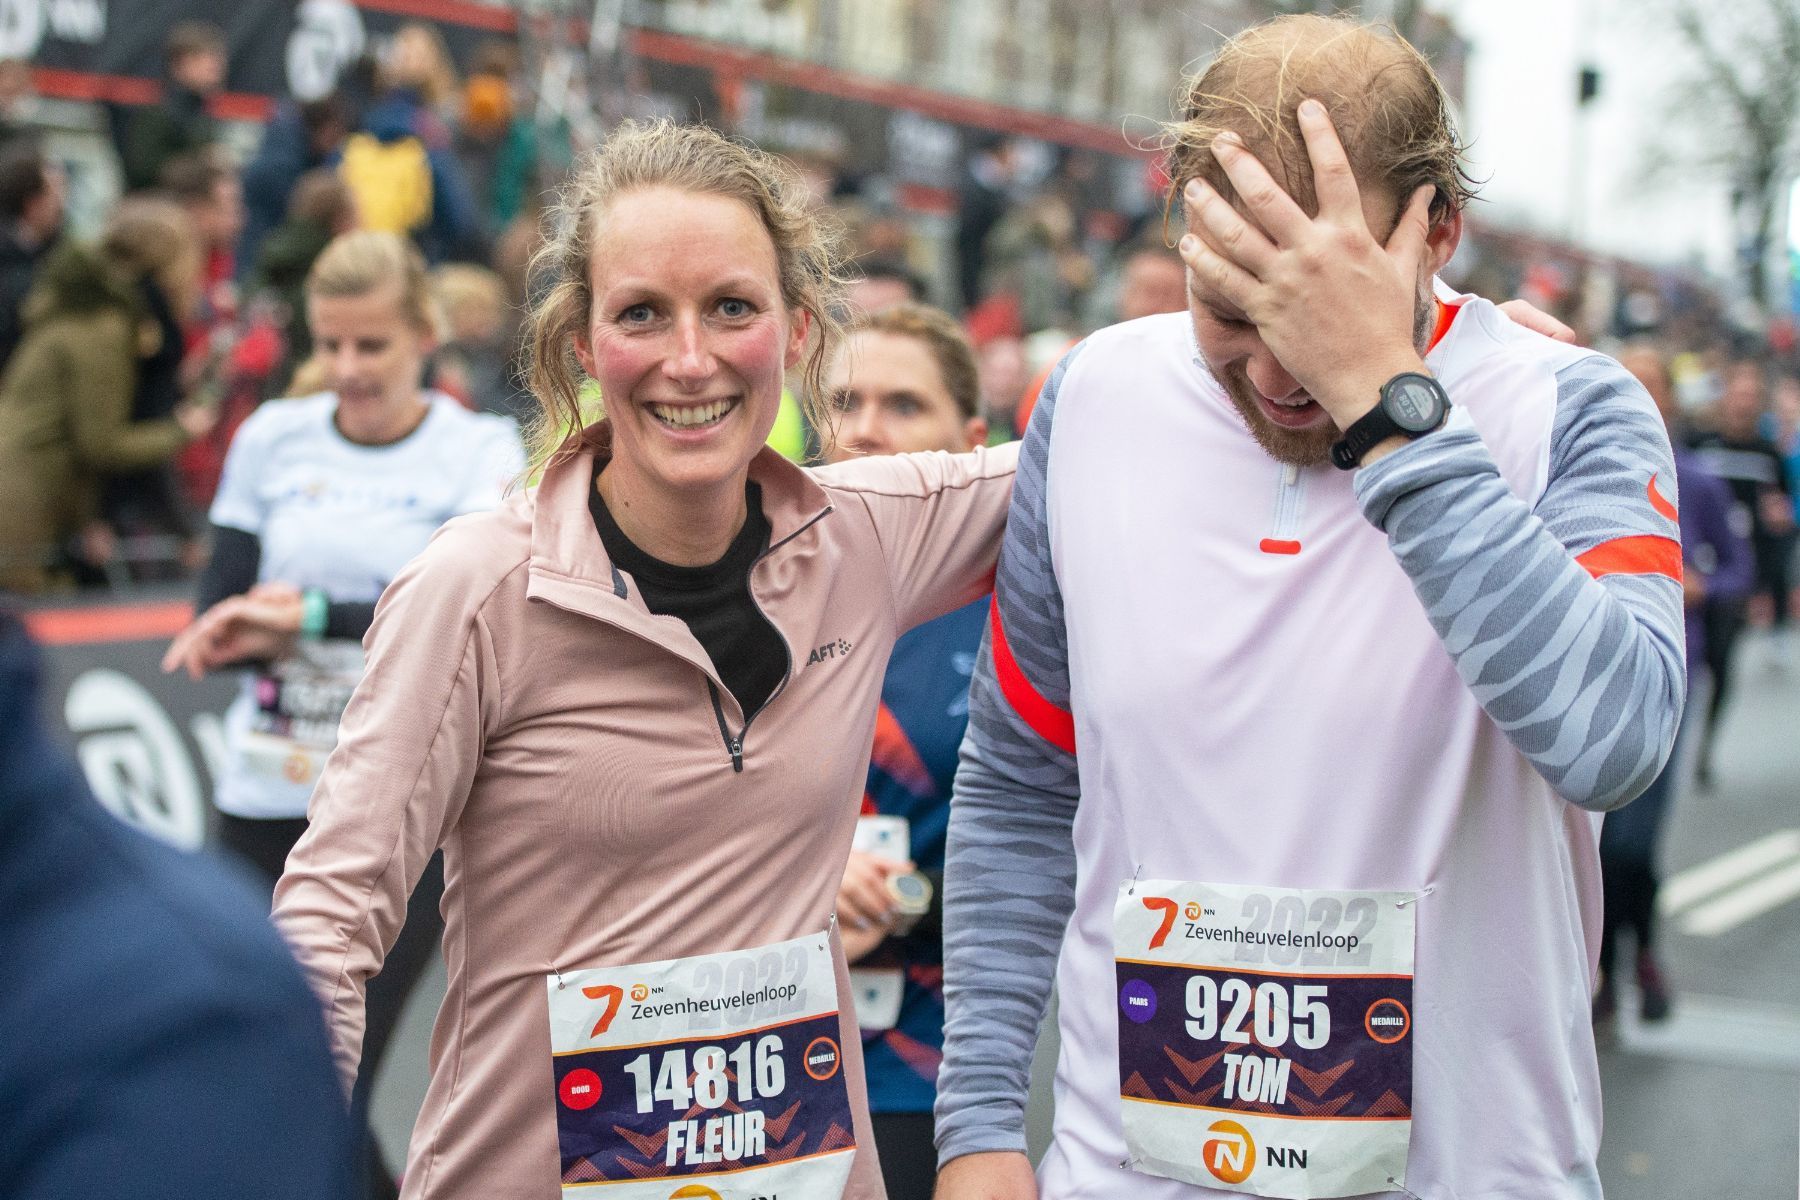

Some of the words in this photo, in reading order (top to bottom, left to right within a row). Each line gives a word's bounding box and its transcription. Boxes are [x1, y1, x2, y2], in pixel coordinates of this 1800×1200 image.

[806, 642, 836, 667] AFT
[1184, 922, 1359, 953] Zevenheuvelenloop
[1234, 893, 1379, 967] 2022
[630, 983, 797, 1020] Zevenheuvelenloop
[687, 945, 809, 1031] 2022
[1185, 975, 1331, 1050] 9205
[1371, 1016, 1404, 1027] MEDAILLE
[624, 1034, 786, 1114] 14816
[808, 1052, 836, 1066] MEDAILLE
[1223, 1053, 1292, 1105] TOM
[665, 1110, 766, 1167] FLEUR
[1266, 1146, 1308, 1169] NN
